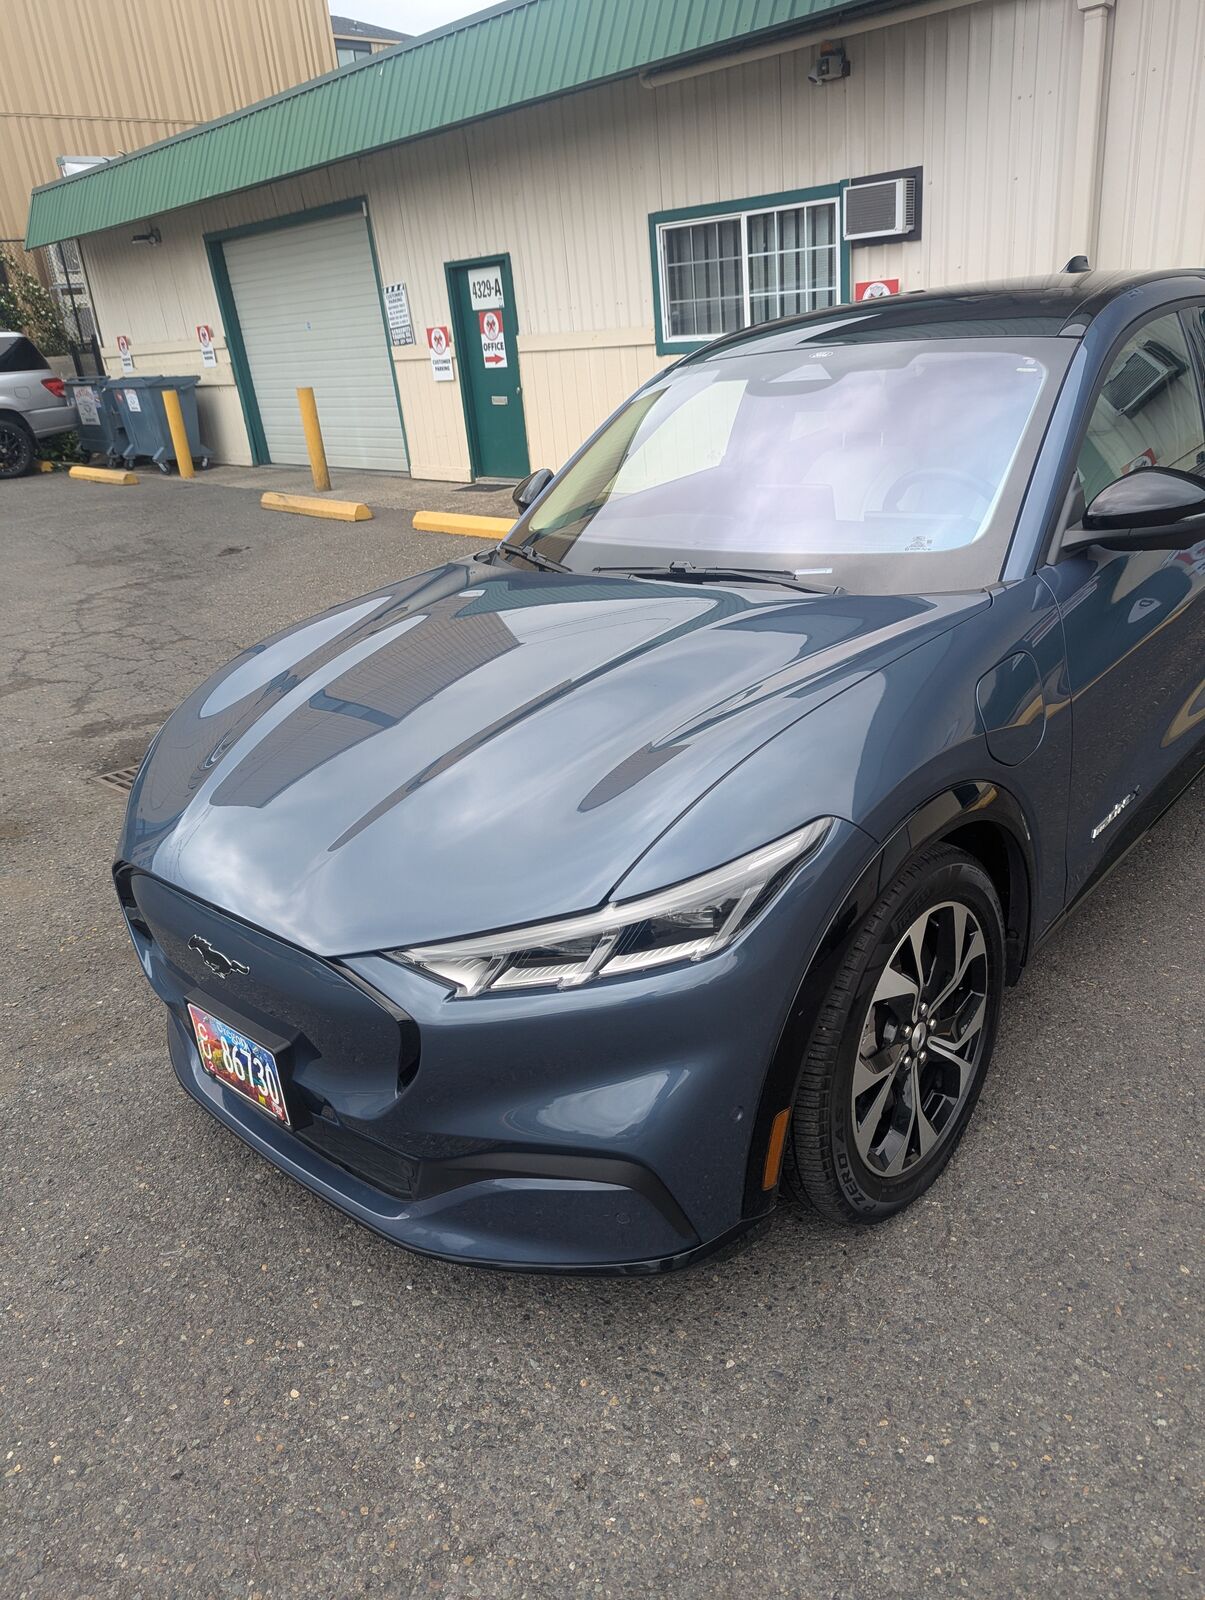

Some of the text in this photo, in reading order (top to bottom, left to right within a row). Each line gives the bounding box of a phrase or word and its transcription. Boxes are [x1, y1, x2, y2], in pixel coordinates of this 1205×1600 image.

[473, 278, 502, 299] 4329-A
[484, 342, 504, 351] OFFICE
[220, 1036, 280, 1104] 86730
